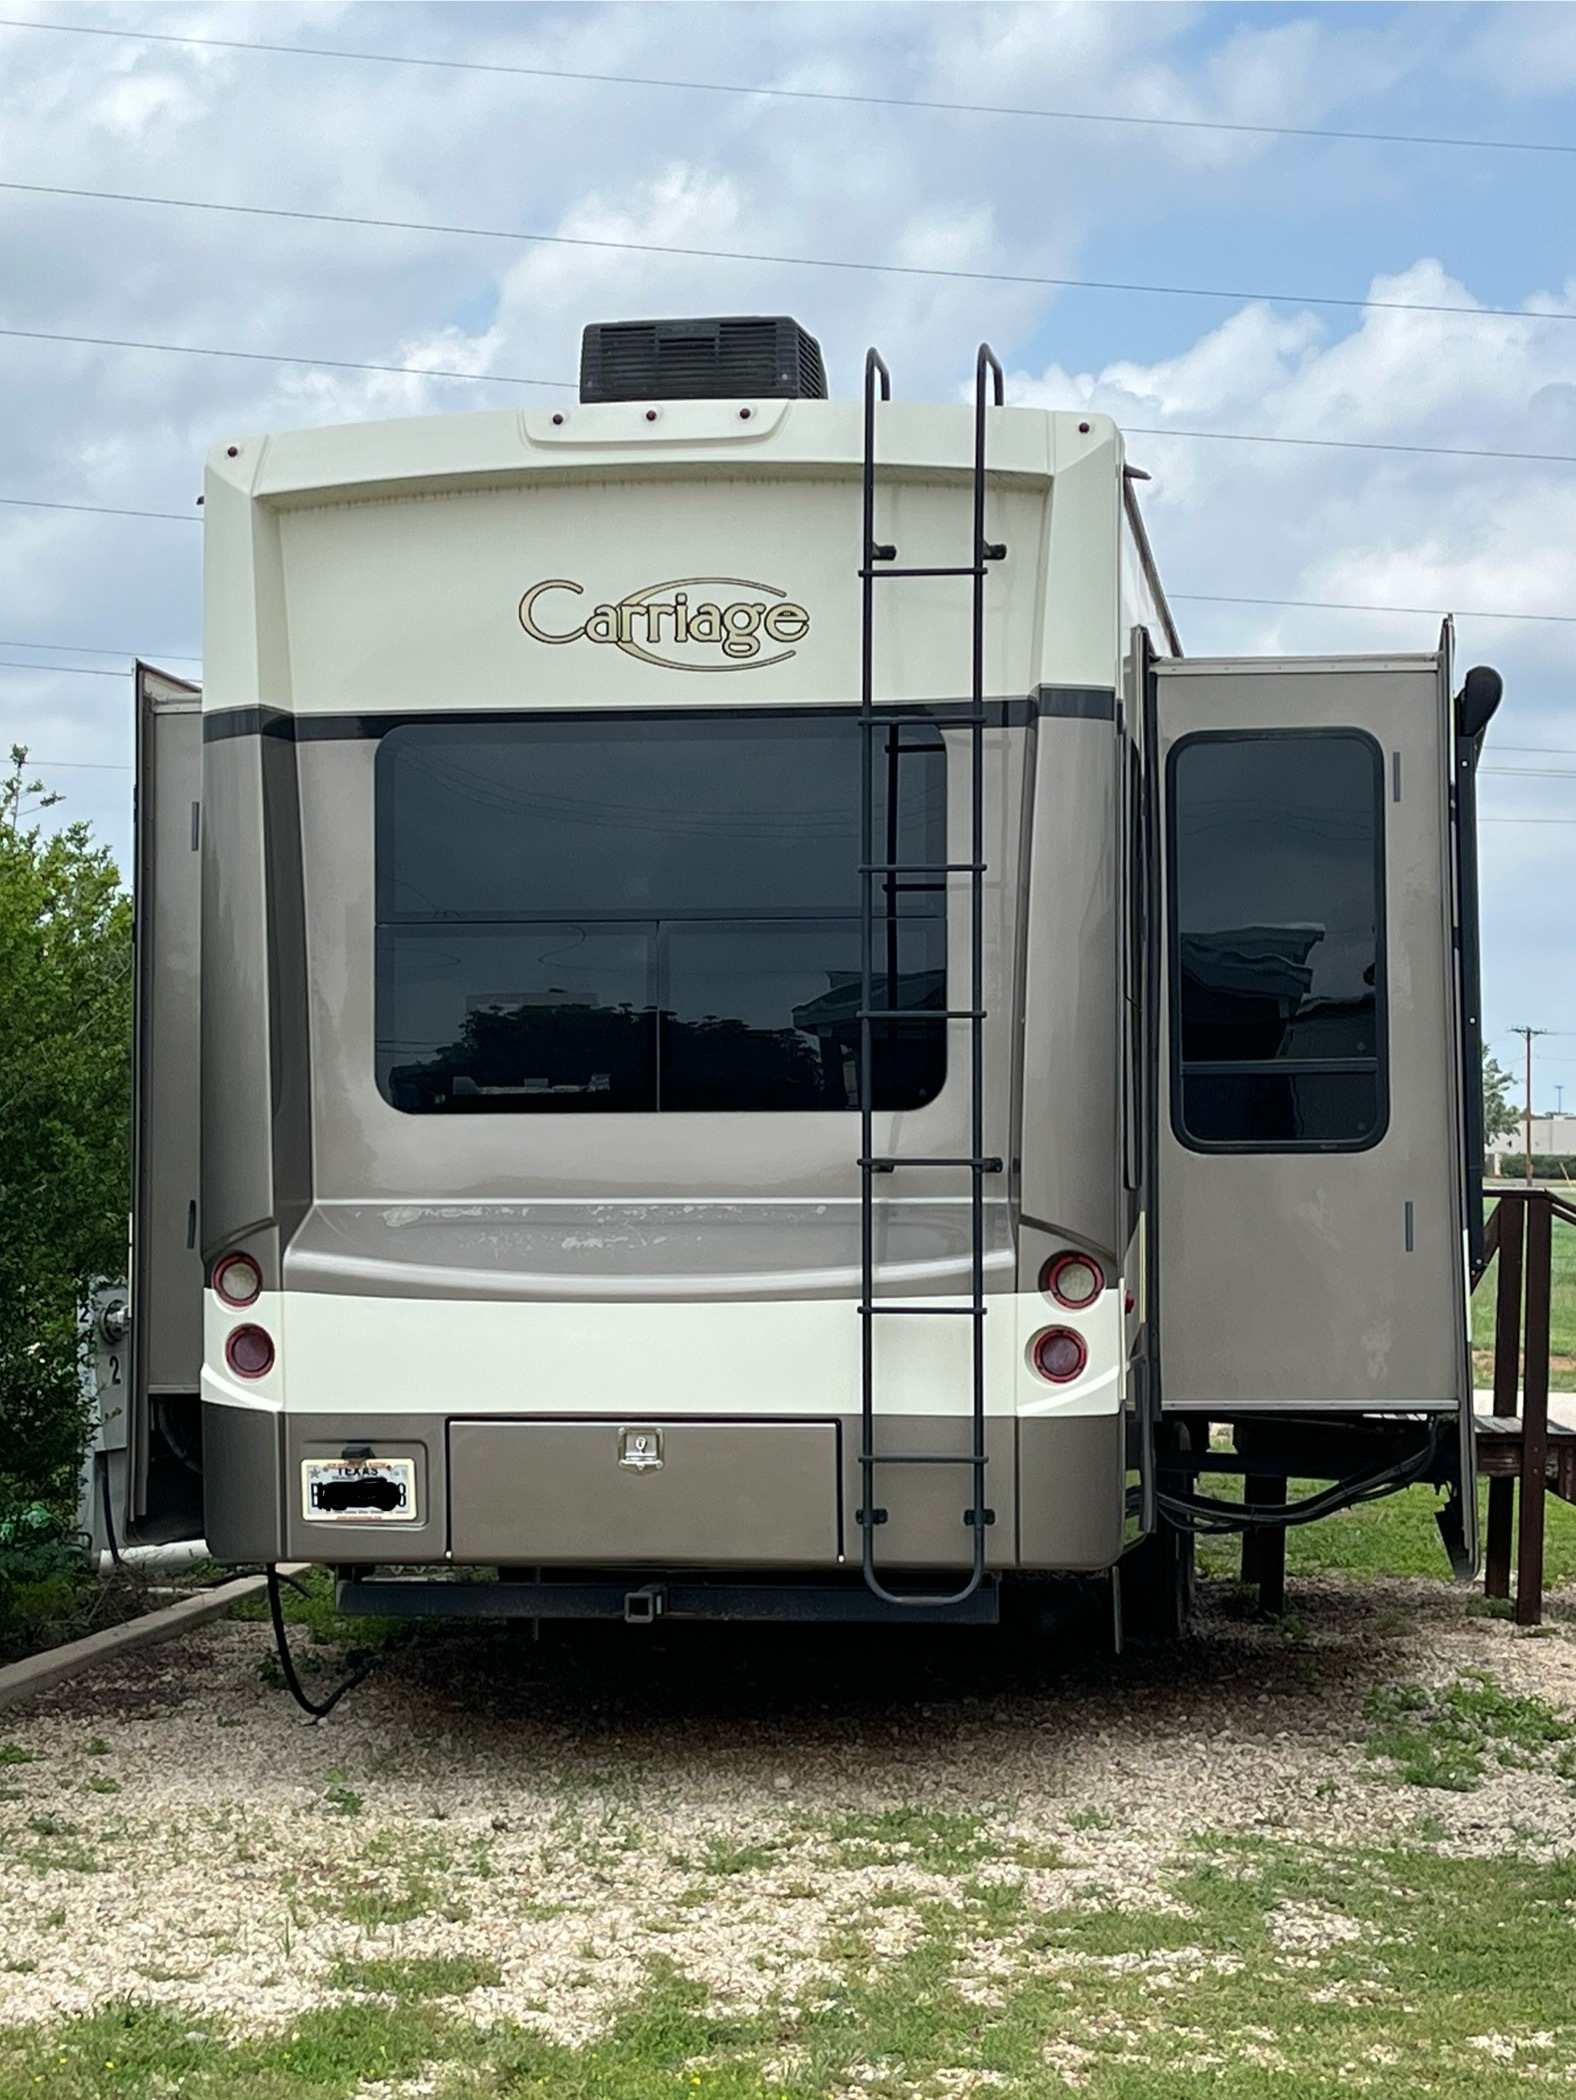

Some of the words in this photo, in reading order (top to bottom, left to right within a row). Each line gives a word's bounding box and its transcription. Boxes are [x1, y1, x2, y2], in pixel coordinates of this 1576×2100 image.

[519, 578, 810, 660] Carriage
[109, 1355, 121, 1385] 2
[338, 1466, 379, 1477] TEXAS
